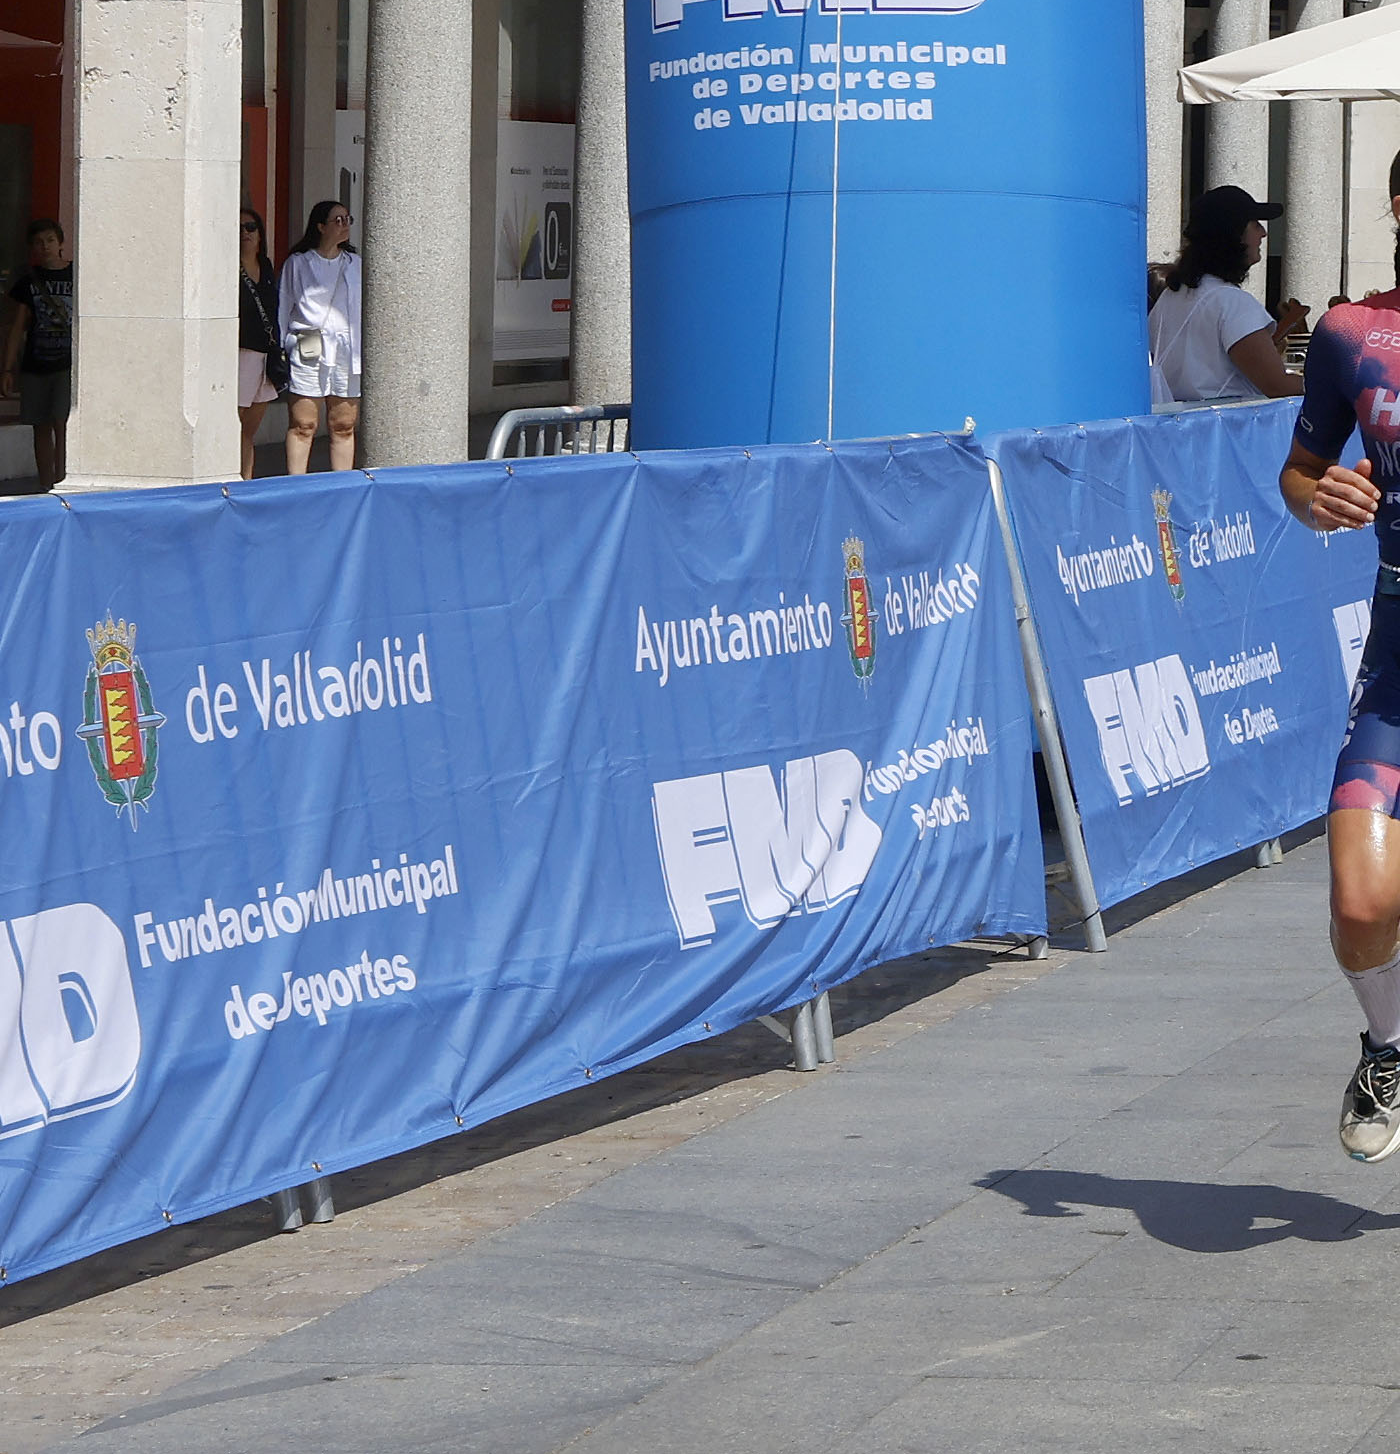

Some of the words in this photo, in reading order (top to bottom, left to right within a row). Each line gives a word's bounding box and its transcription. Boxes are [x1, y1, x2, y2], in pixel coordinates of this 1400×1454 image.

[649, 44, 793, 82] Fundación
[810, 42, 1007, 67] Municipal
[693, 77, 728, 100] de
[740, 68, 936, 95] Deportes
[694, 105, 730, 131] de
[740, 98, 933, 125] Valladolid
[1189, 521, 1212, 569] de
[635, 591, 833, 687] Ayuntamiento
[884, 576, 905, 637] de
[186, 665, 238, 744] de
[242, 633, 432, 732] Valladolid
[1224, 712, 1244, 746] de
[133, 881, 316, 970] Fundación
[223, 984, 277, 1040] de
